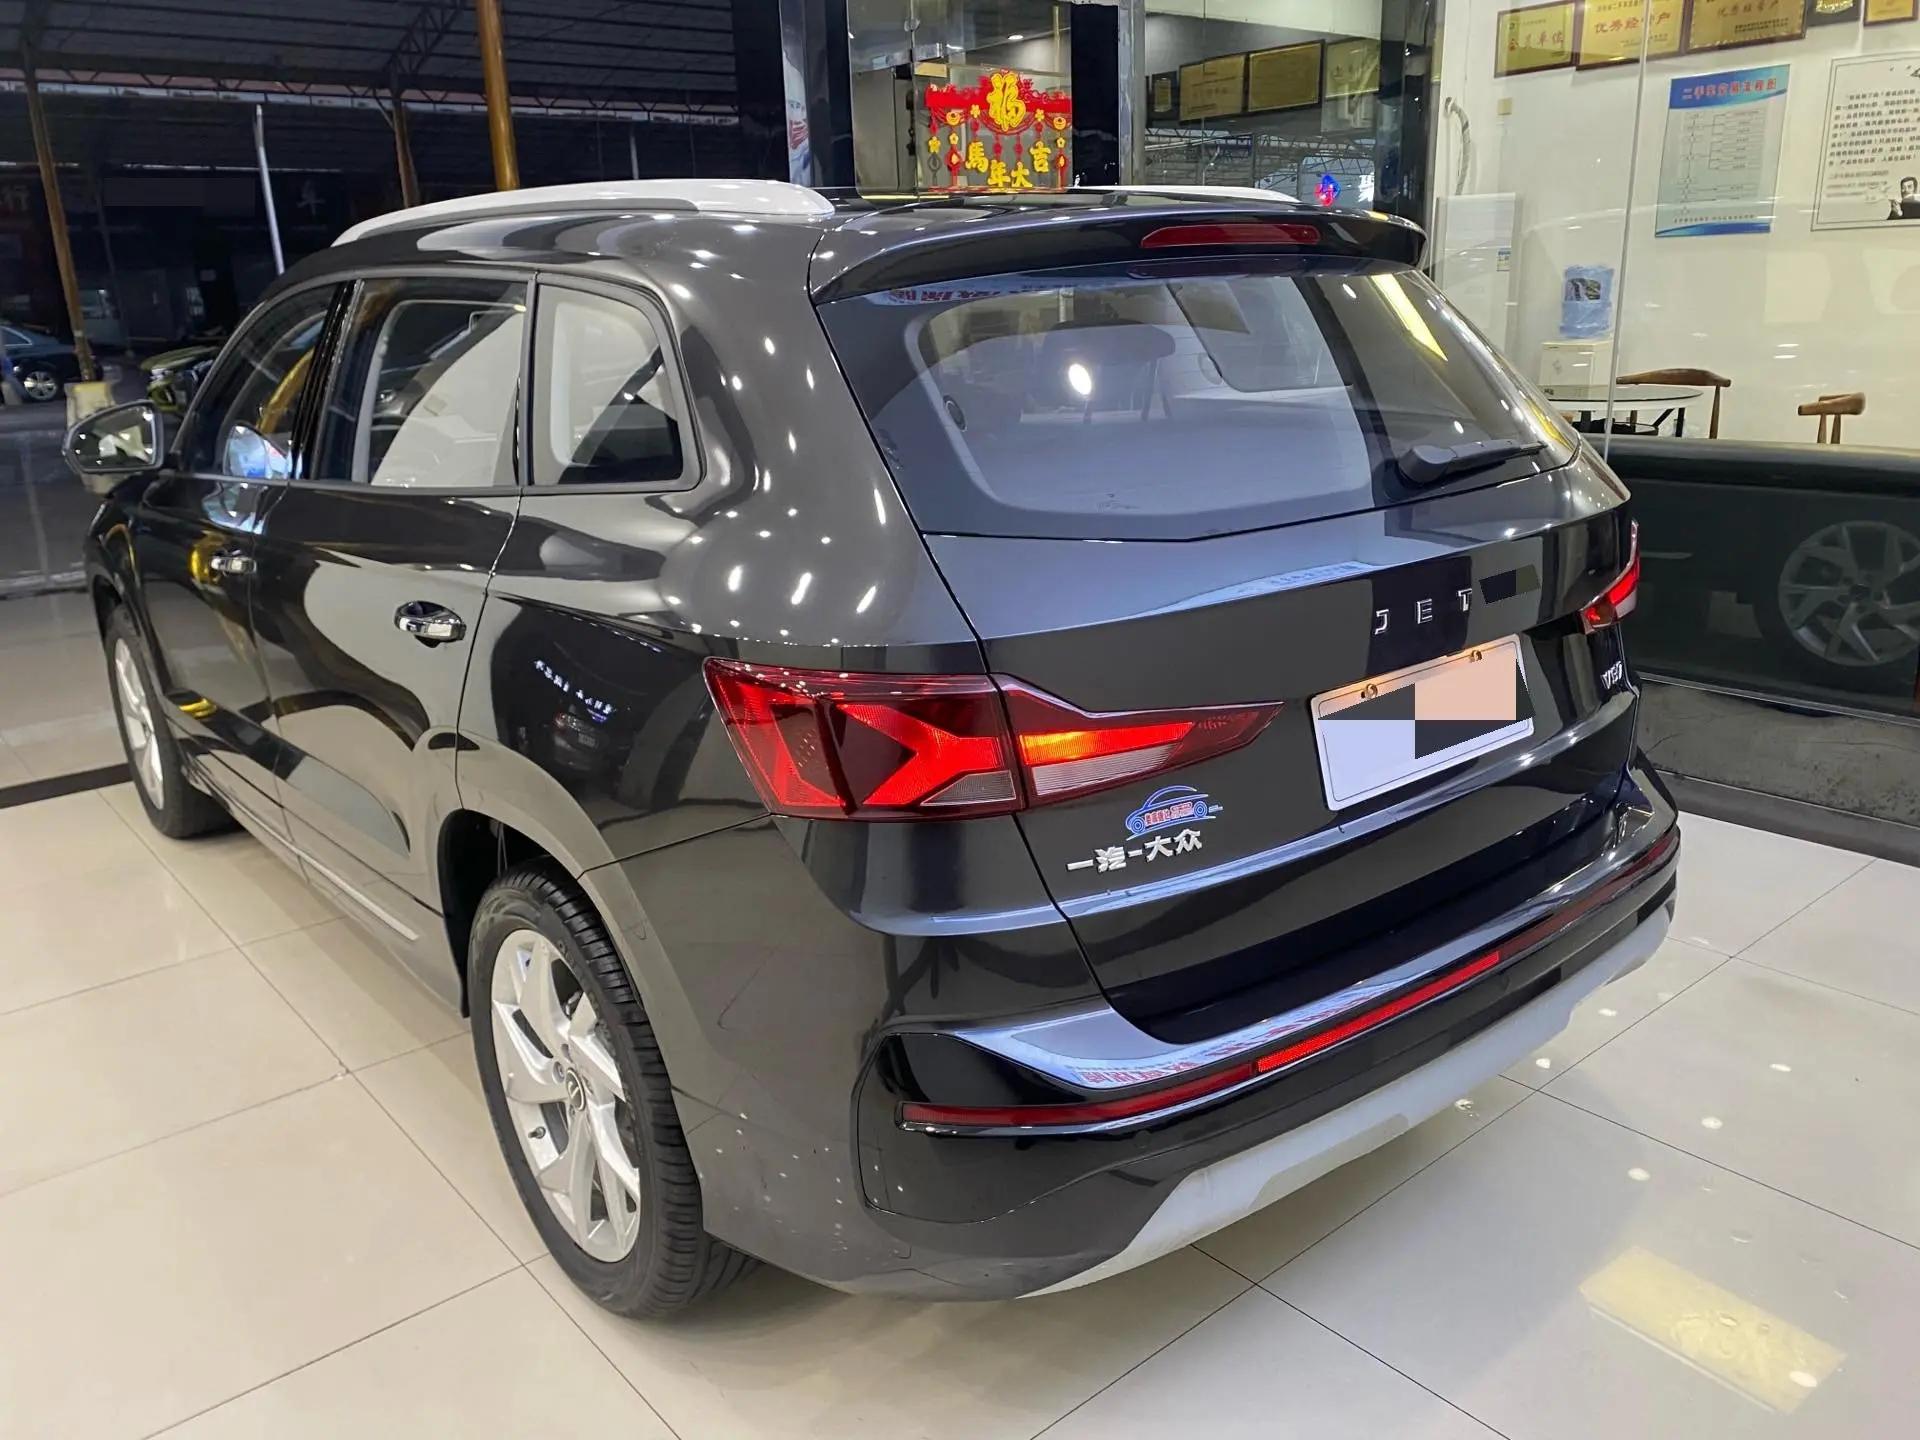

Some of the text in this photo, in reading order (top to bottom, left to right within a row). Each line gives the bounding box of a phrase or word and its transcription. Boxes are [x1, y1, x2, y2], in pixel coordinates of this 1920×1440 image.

[1594, 11, 1672, 34] 优秀经户
[986, 71, 1027, 132] 福
